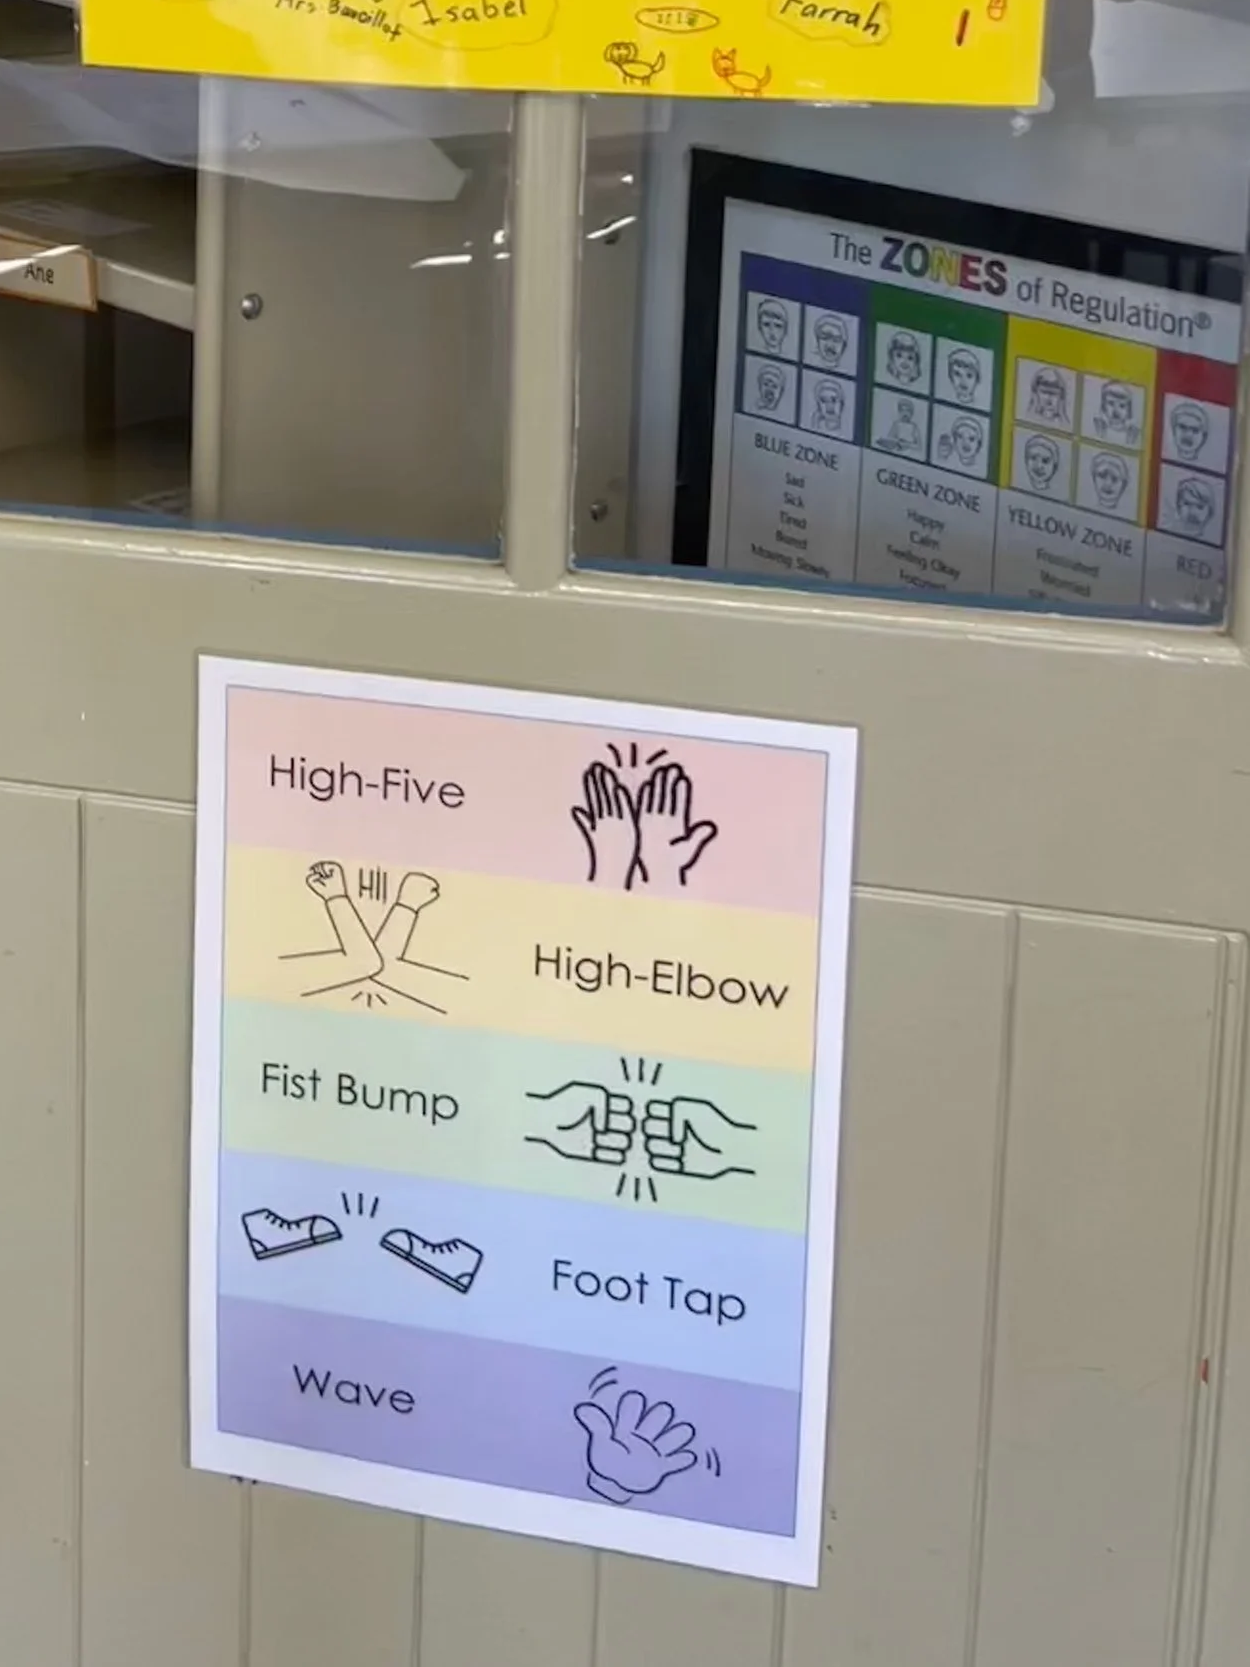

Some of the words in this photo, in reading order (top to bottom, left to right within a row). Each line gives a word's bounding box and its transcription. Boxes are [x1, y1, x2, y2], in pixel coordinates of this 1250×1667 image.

[830, 232, 872, 267] The
[880, 236, 1008, 296] ZONES
[1016, 276, 1042, 304] of
[754, 432, 791, 458] BLUE
[794, 445, 840, 472] ZONE
[876, 468, 929, 498] GREEN
[934, 484, 981, 514] ZONE
[1008, 504, 1077, 542] YELLOW
[1081, 527, 1133, 558] ZONE
[1176, 554, 1213, 581] RED
[268, 754, 466, 809] High-Five
[533, 944, 790, 1010] High-Elbow
[261, 1062, 322, 1103] Fist
[337, 1072, 460, 1125] Bump
[552, 1259, 650, 1304] Foot
[663, 1276, 747, 1326] Tap
[293, 1364, 416, 1415] Wave
